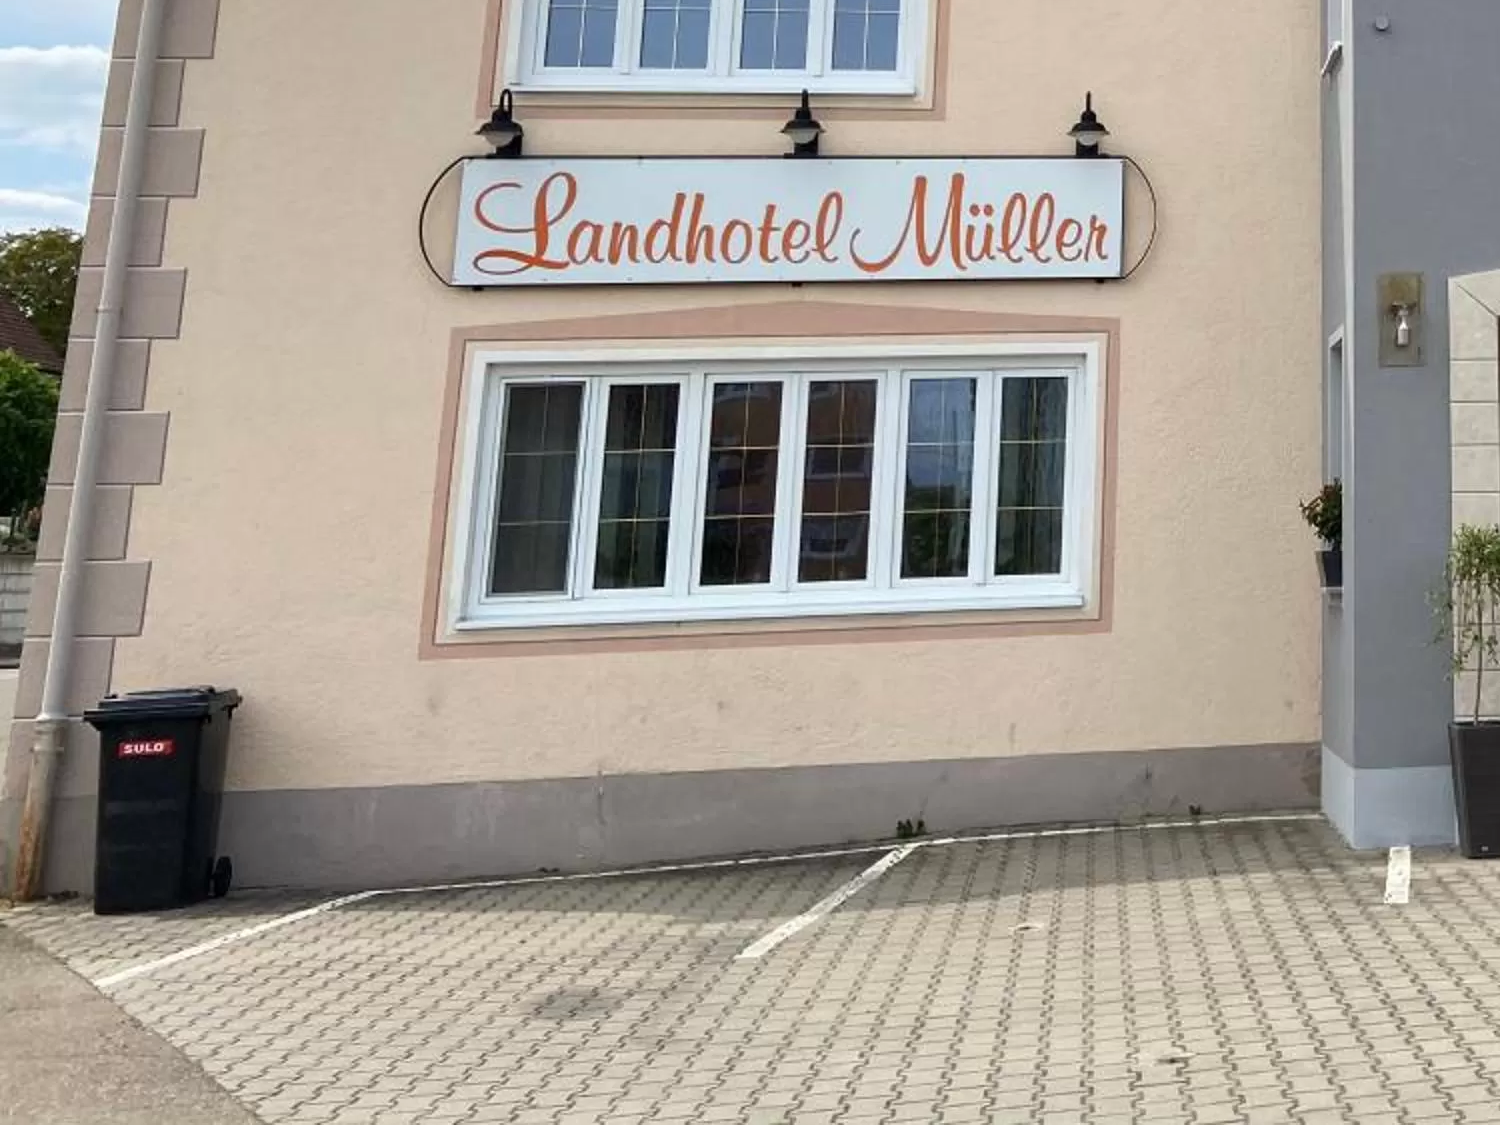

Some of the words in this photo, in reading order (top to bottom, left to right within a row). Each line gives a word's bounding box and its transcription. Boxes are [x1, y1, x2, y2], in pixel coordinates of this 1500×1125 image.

[472, 172, 843, 275] Landhotel
[850, 173, 1108, 273] Müller
[123, 742, 165, 755] SULO
